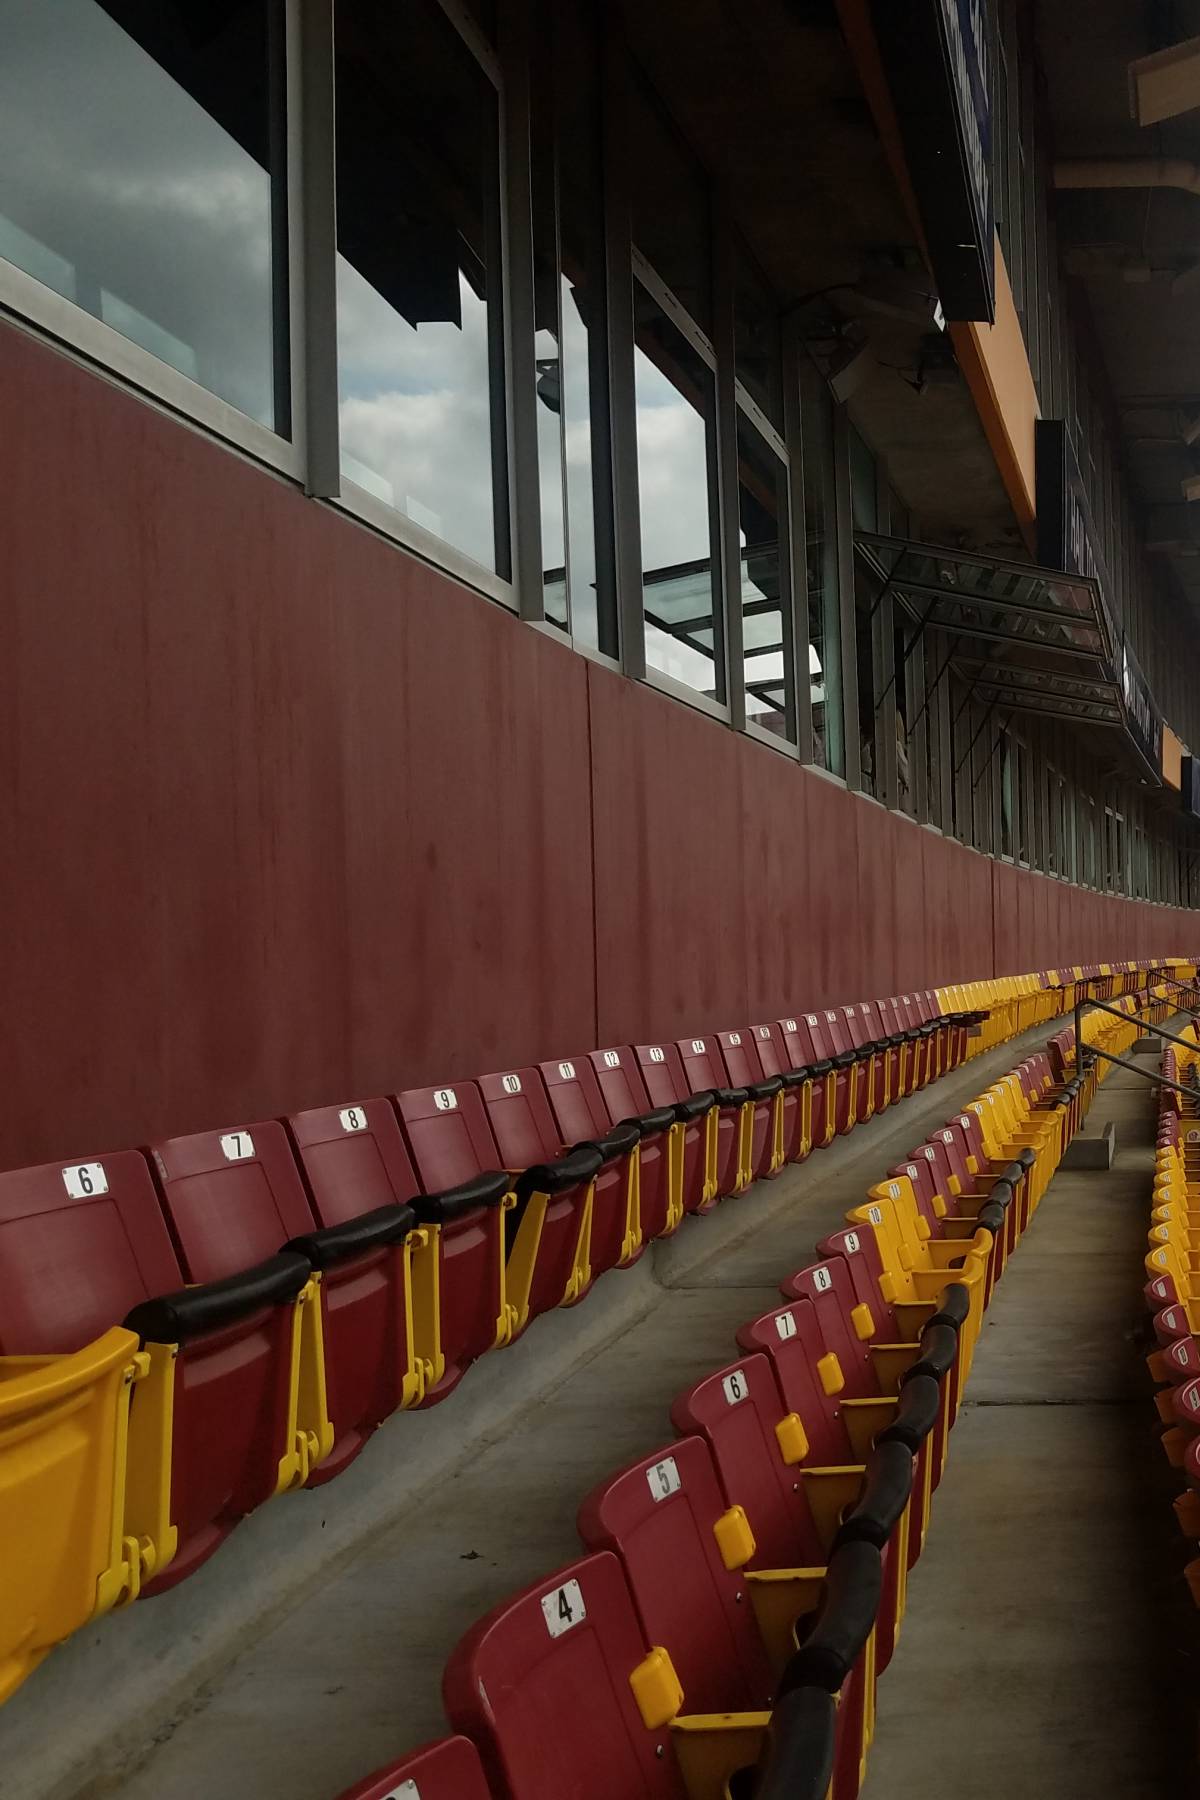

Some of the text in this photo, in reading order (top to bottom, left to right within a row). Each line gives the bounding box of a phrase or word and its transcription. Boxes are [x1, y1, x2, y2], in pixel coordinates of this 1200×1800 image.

[652, 1048, 662, 1061] 13
[694, 1041, 703, 1052] 14
[607, 1053, 618, 1065] 12
[562, 1064, 571, 1077] 11
[506, 1077, 518, 1092] 10
[439, 1091, 449, 1109] 9
[348, 1110, 359, 1129] 8
[230, 1135, 242, 1158] 7
[78, 1167, 93, 1194] 6
[871, 1207, 880, 1222] 10
[848, 1234, 856, 1250] 9
[818, 1270, 826, 1288] 8
[782, 1315, 789, 1336] 7
[730, 1375, 741, 1400] 6
[655, 1464, 671, 1494] 5
[558, 1588, 573, 1623] 4
